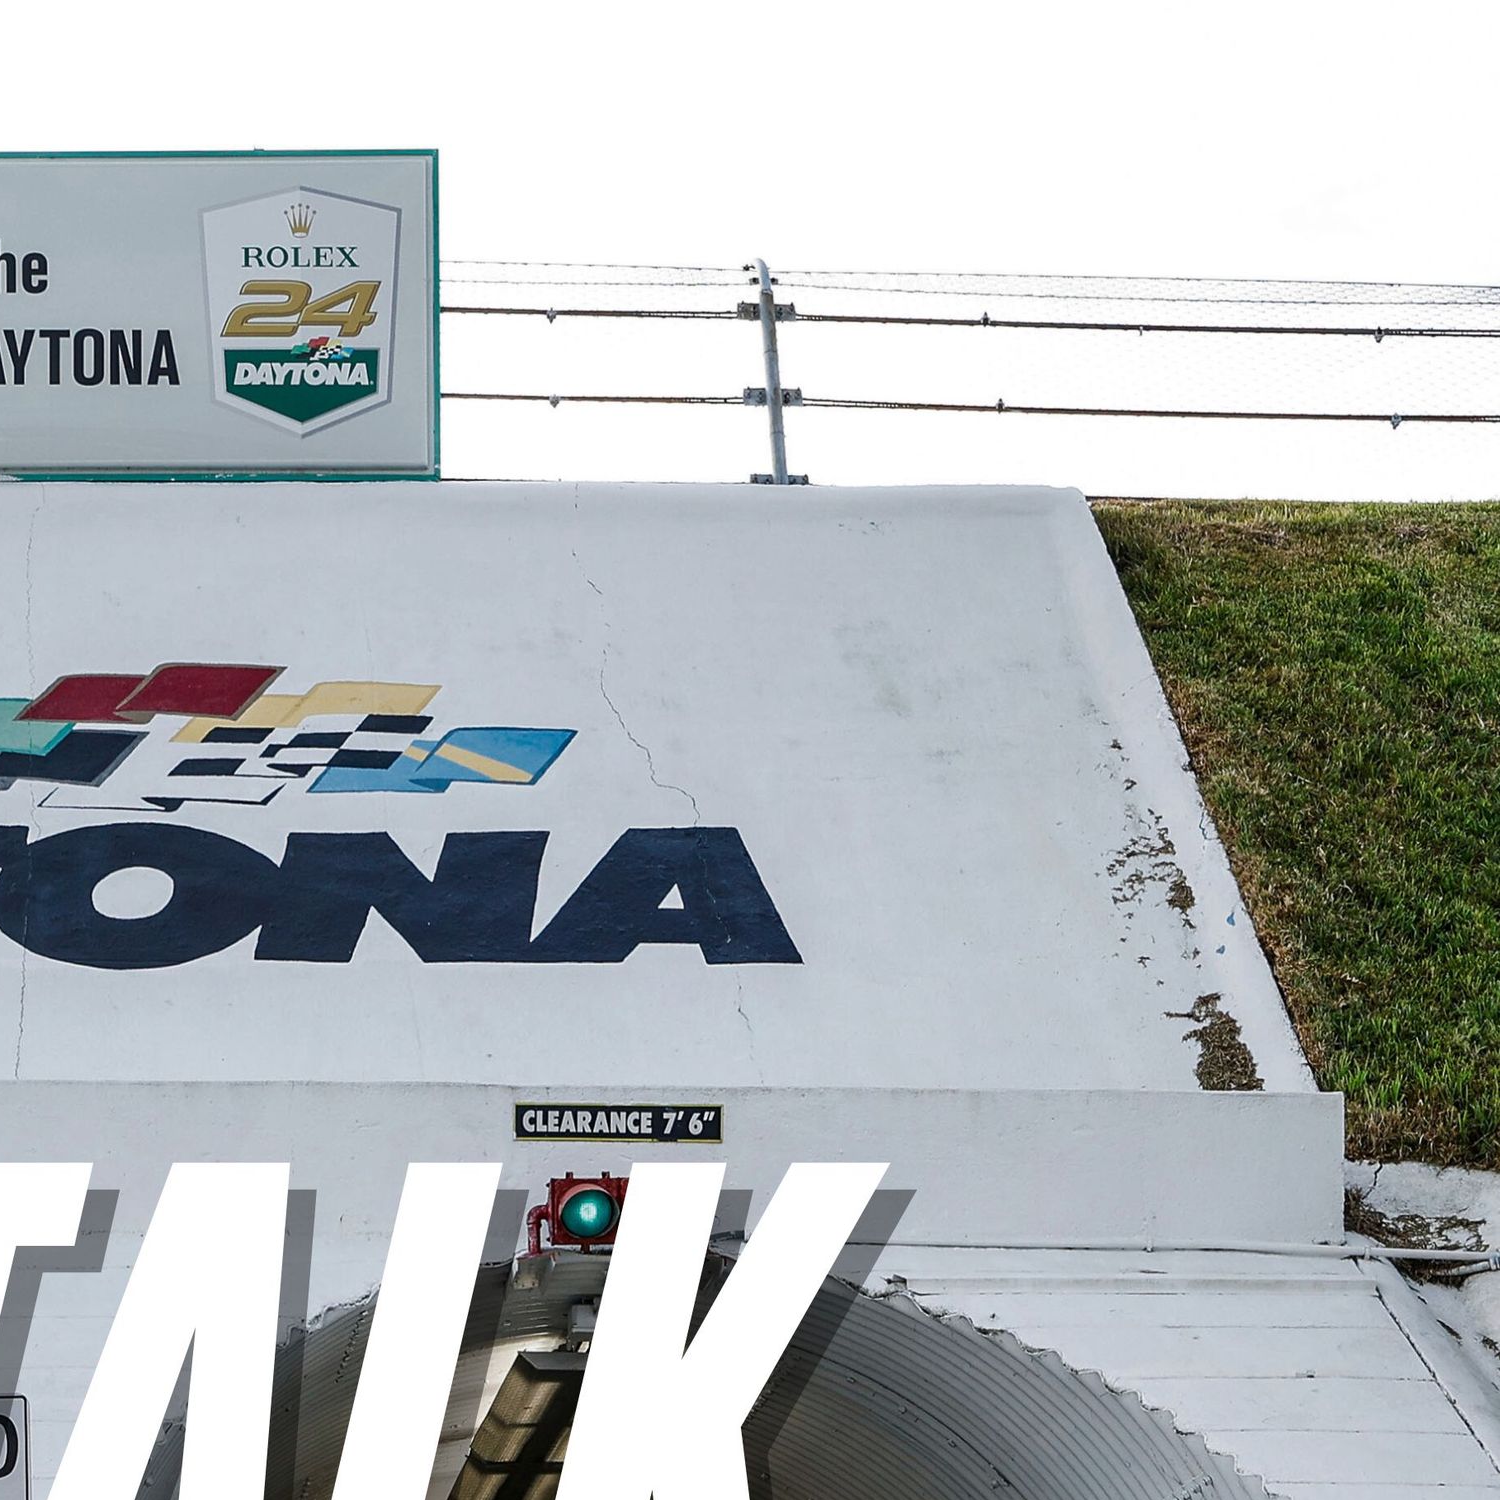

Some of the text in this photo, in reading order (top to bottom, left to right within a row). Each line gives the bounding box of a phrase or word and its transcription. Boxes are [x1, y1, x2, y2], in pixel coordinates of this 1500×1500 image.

[241, 246, 360, 268] ROLEX
[219, 279, 382, 338] 24
[233, 362, 370, 386] DAYTONA
[522, 1110, 653, 1135] CLEARANCE
